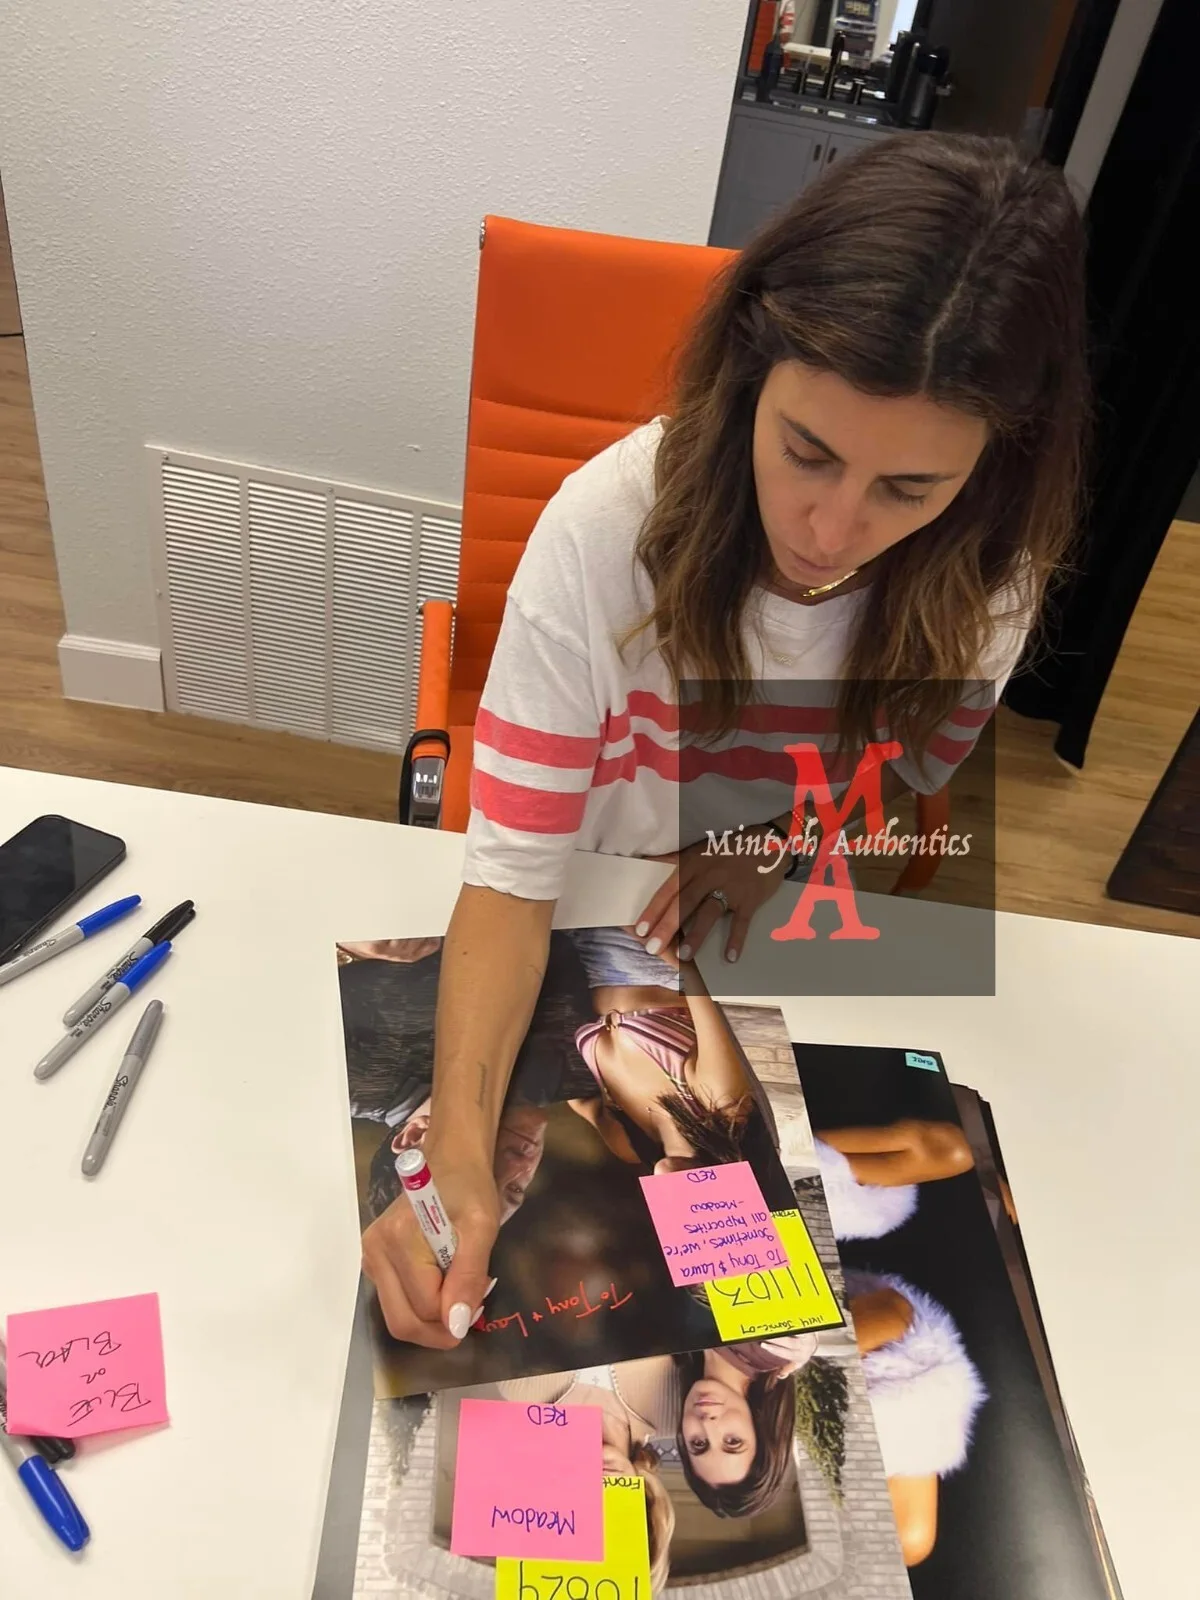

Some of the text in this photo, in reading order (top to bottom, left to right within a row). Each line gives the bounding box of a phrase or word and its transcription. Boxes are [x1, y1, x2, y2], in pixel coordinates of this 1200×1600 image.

[81, 997, 112, 1028] Sharpie
[102, 1072, 129, 1111] Sharpie
[687, 1170, 717, 1183] RED
[684, 1211, 767, 1234] all hypocrites
[730, 1252, 765, 1270] Tony
[766, 1249, 788, 1267] To
[680, 1262, 716, 1278] Laura
[545, 1281, 602, 1319] Tony
[600, 1283, 633, 1310] To
[527, 1405, 568, 1426] RED
[602, 1477, 640, 1489] Front
[491, 1505, 575, 1535] Meadow
